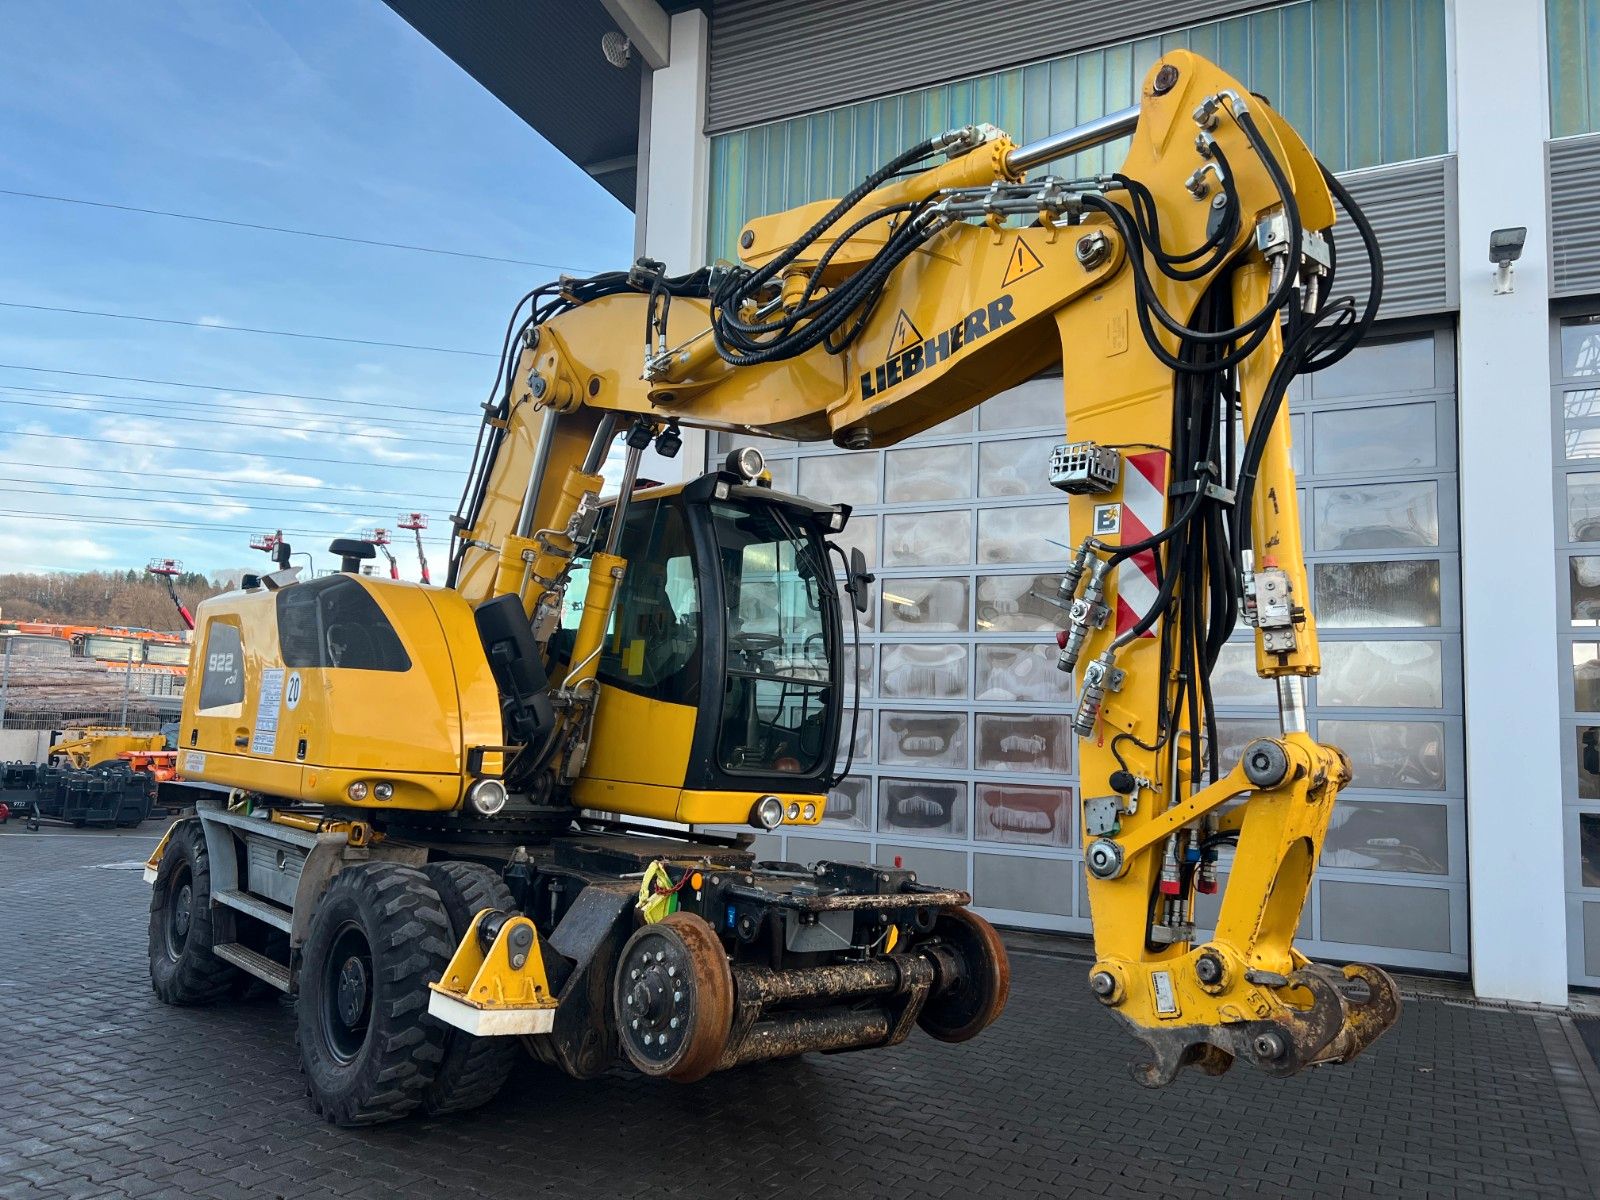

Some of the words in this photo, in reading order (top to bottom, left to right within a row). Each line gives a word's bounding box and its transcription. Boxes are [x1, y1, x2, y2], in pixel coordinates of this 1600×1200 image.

[861, 294, 1017, 401] LIEBHERR
[208, 652, 234, 672] 922
[287, 677, 300, 702] 20
